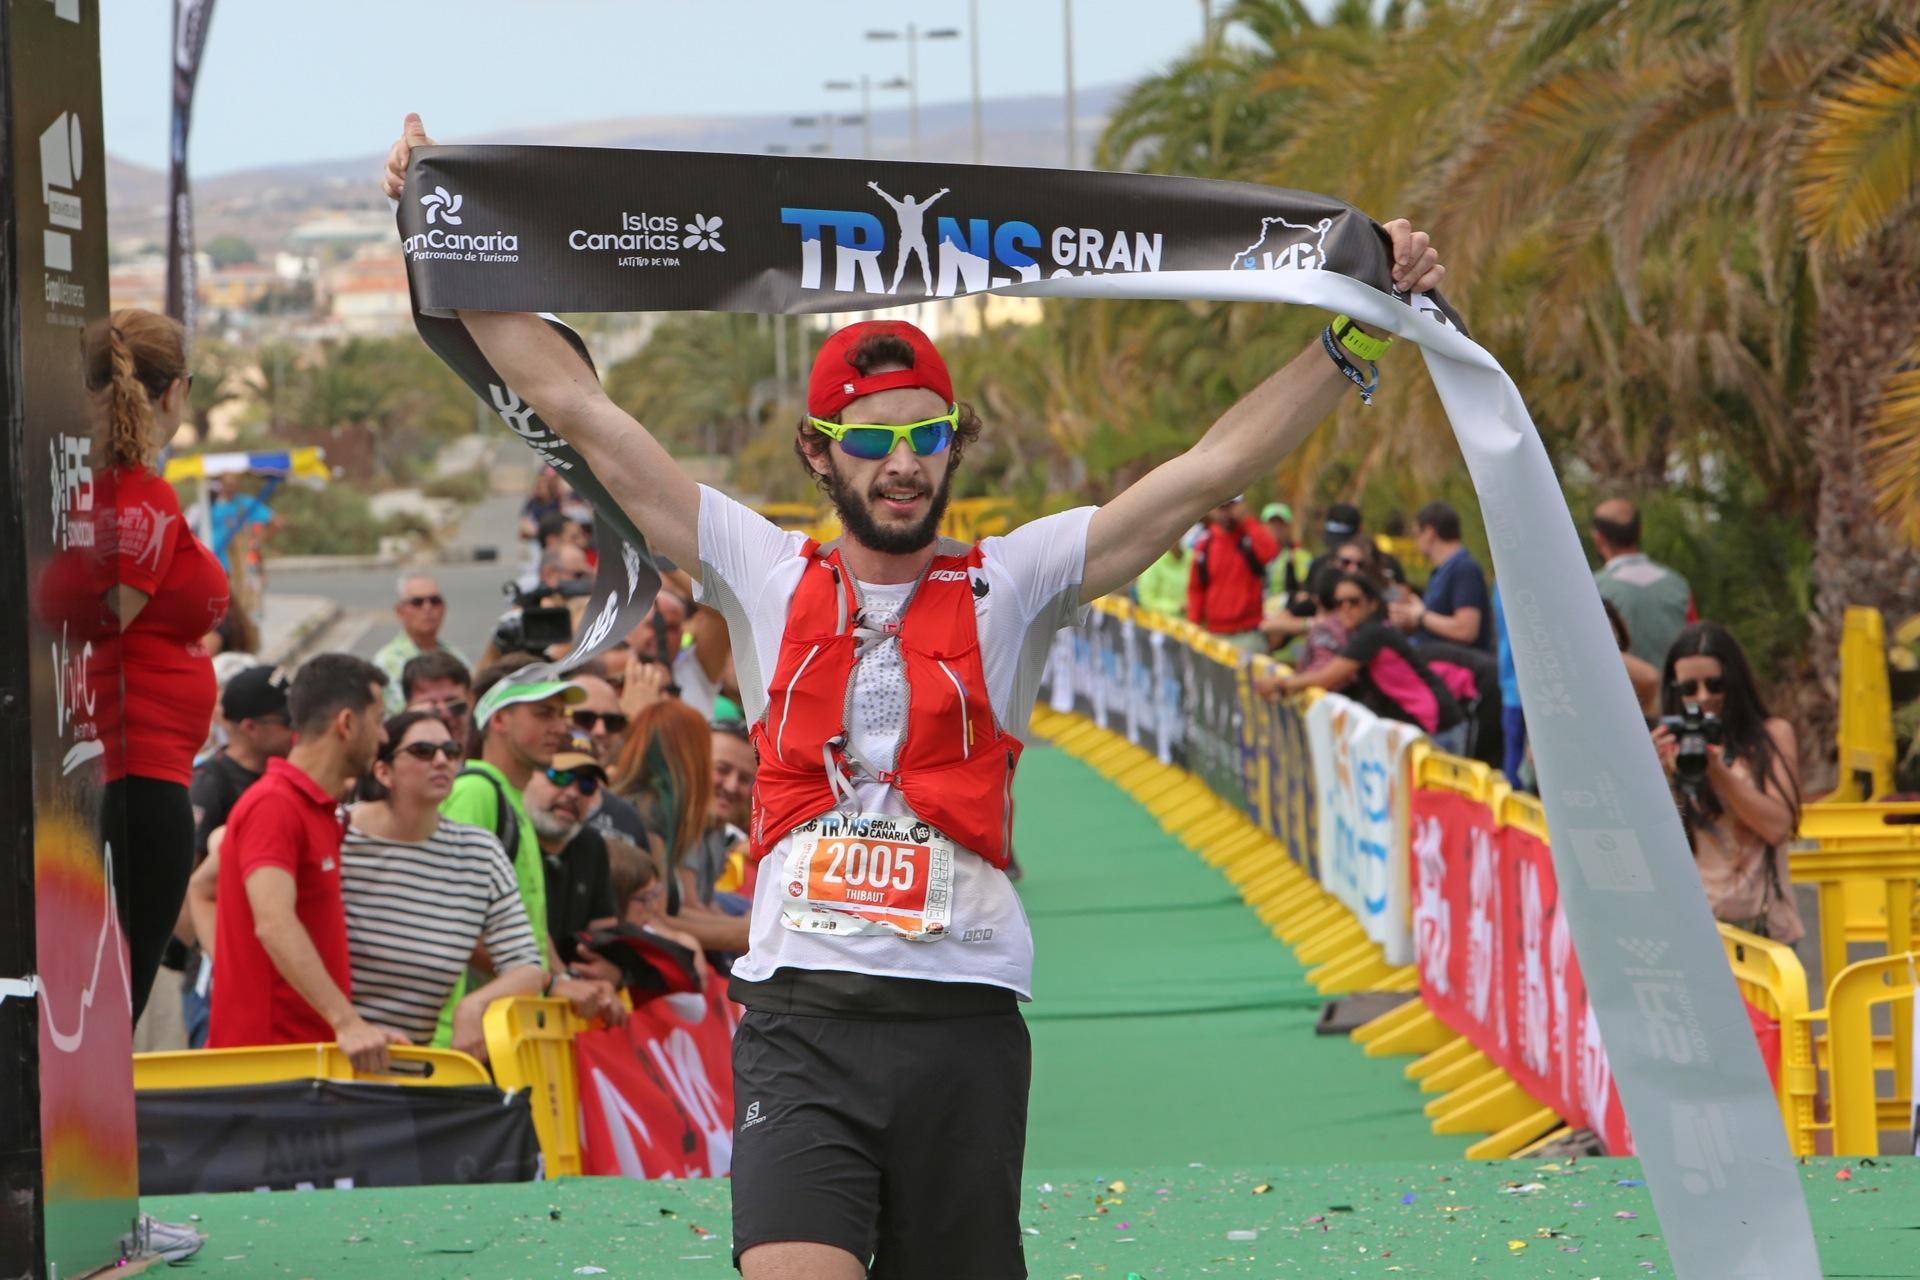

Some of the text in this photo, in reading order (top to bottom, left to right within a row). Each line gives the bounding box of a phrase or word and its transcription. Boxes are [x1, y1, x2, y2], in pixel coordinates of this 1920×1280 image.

[622, 211, 679, 232] Islas
[403, 229, 518, 254] anCanaria
[568, 229, 680, 251] Canarias
[1051, 226, 1163, 272] GRAN
[413, 251, 519, 263] Patronato de Turismo
[651, 258, 661, 266] DE
[662, 257, 680, 266] VIDA
[871, 820, 896, 831] GRAN
[870, 829, 911, 842] CANARIA
[822, 842, 916, 891] 2005
[845, 888, 885, 903] THIBAUT
